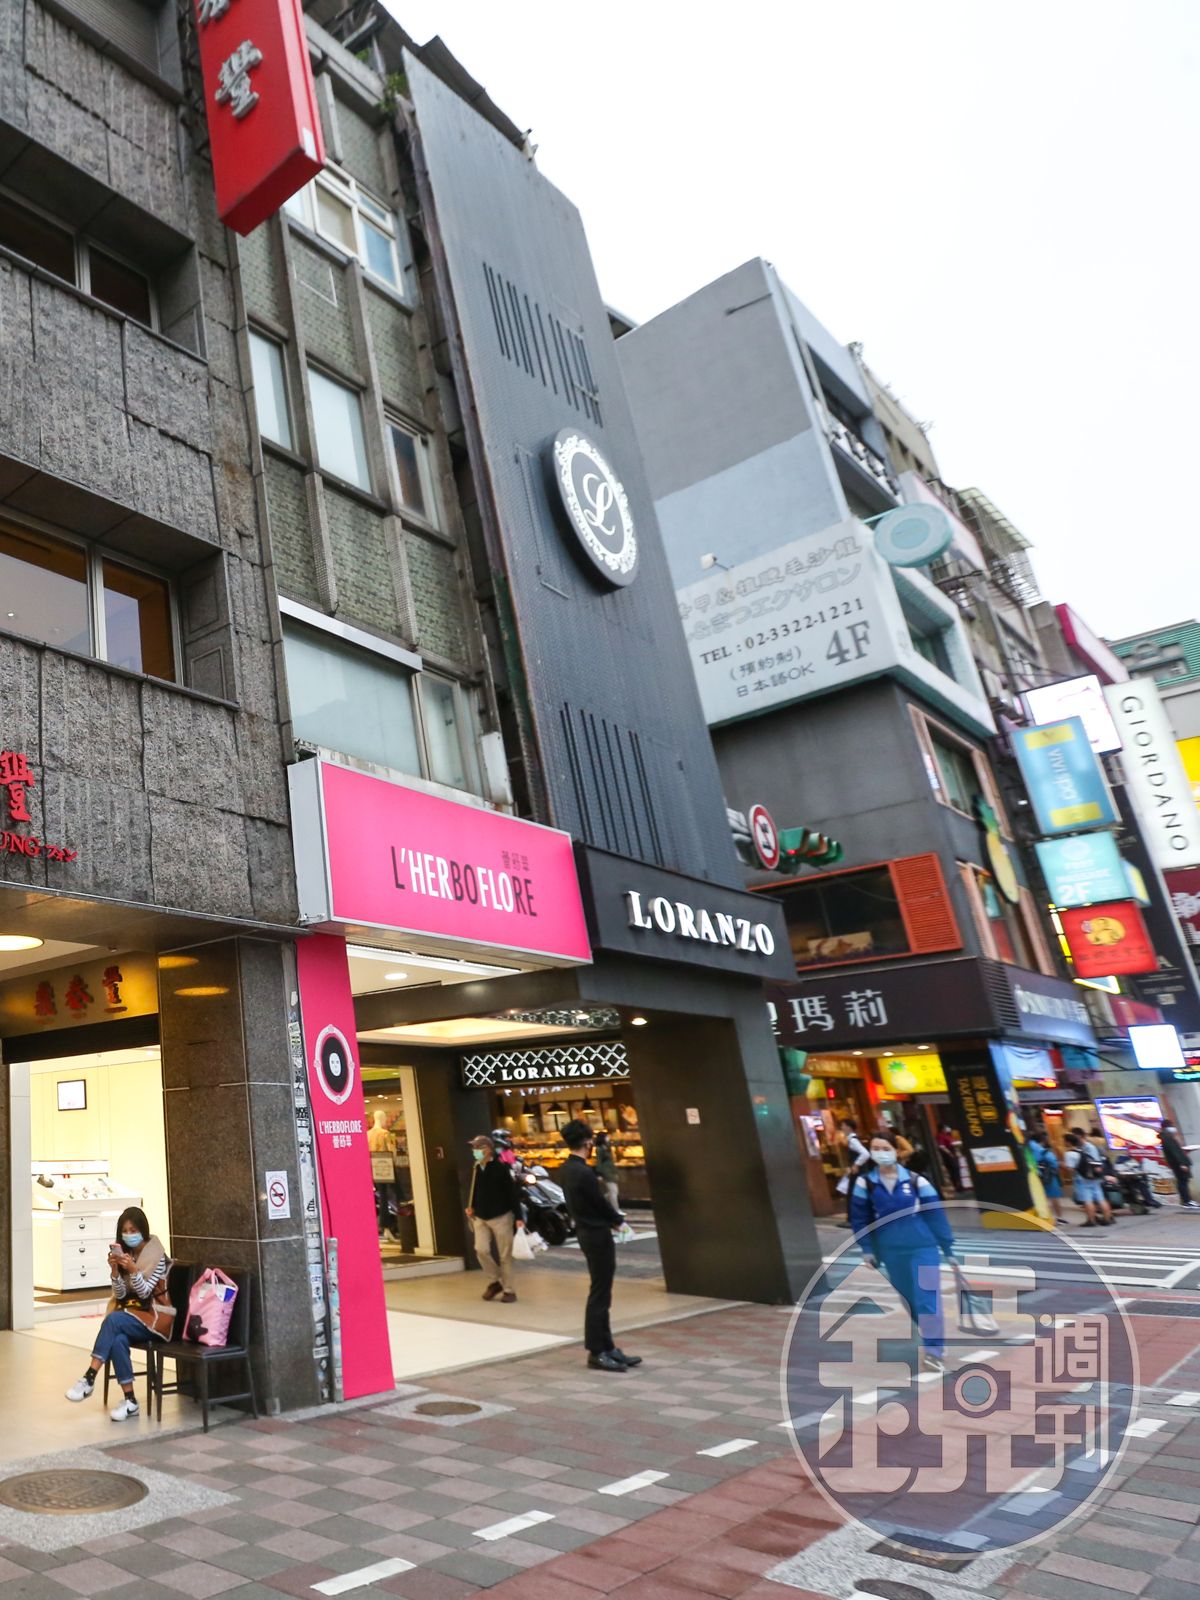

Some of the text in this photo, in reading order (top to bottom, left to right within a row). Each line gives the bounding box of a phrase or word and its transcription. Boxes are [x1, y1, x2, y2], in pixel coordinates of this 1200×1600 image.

[745, 598, 864, 650] 02-3322-1221
[826, 620, 871, 666] 4F
[1120, 696, 1189, 851] GIORDANO
[391, 846, 537, 917] L'HERBOFLORE
[627, 890, 775, 956] LORANZO
[501, 1063, 596, 1081] LORANZO
[318, 1120, 363, 1134] L'HERBOFLORE
